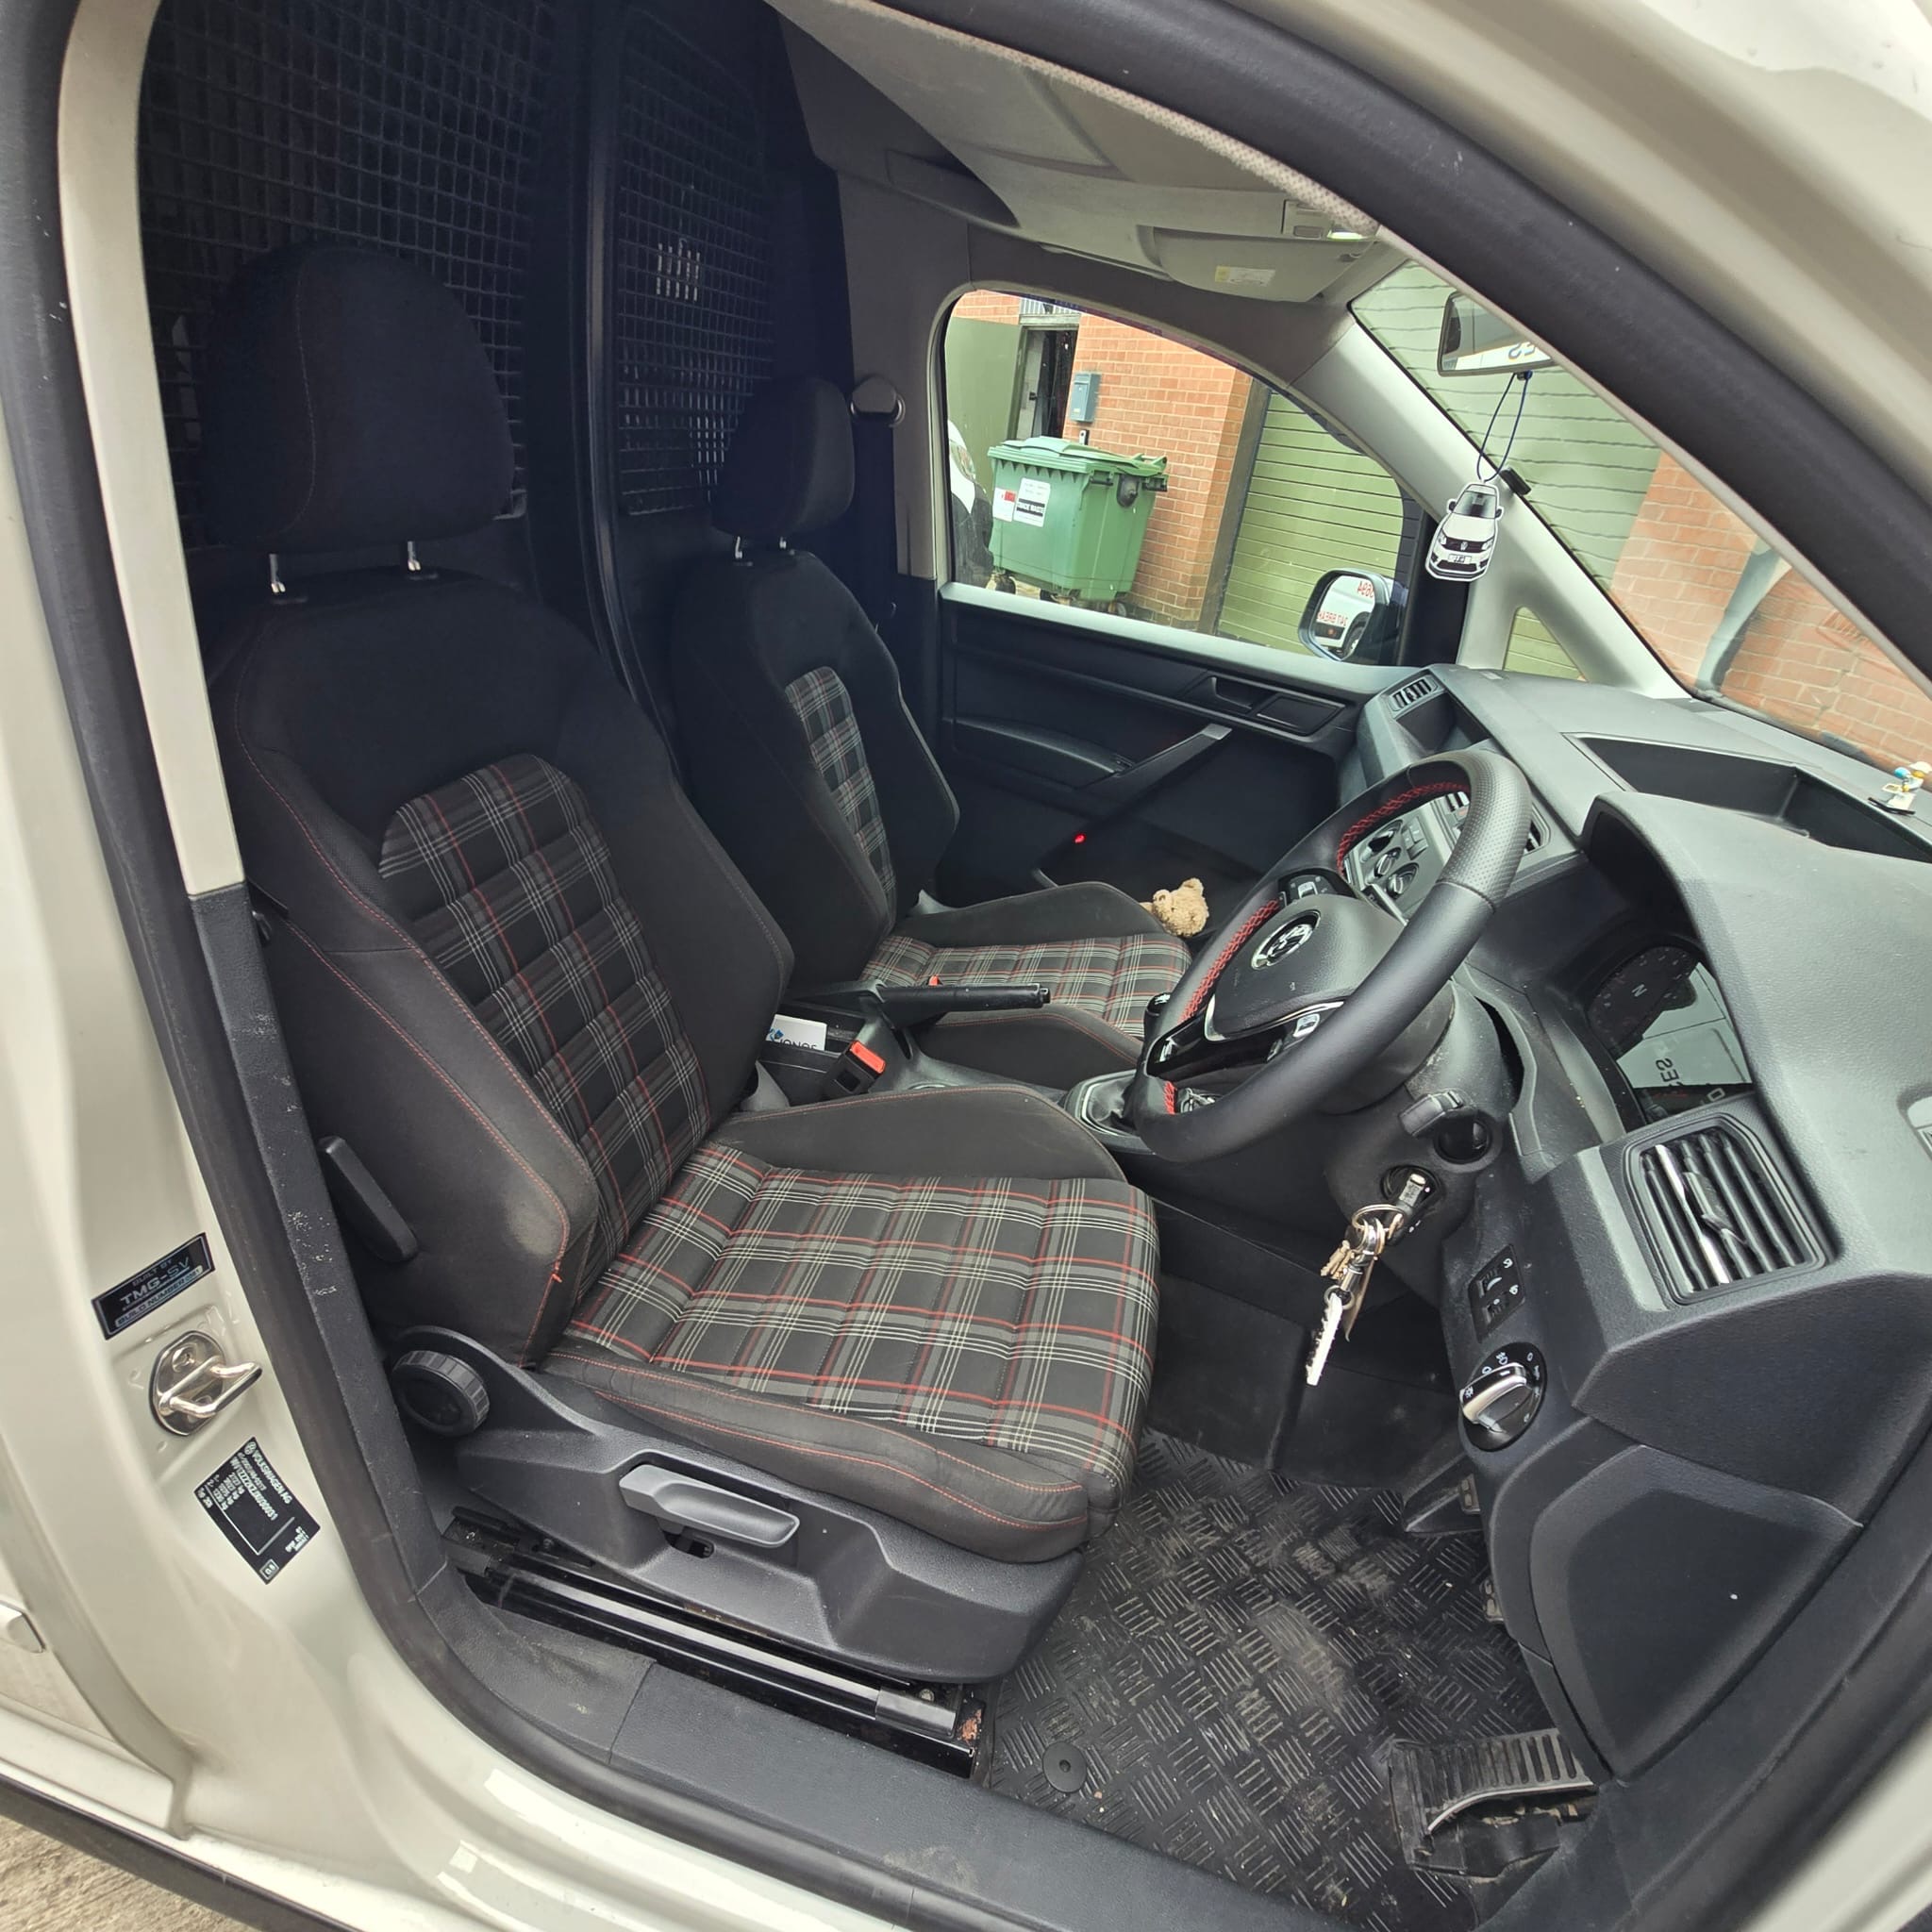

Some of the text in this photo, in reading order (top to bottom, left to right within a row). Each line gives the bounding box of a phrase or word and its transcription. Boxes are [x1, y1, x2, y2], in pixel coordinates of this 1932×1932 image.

[121, 1257, 190, 1305] TMG-SV
[252, 1450, 286, 1492] VOLKSWAGEN
[281, 1491, 292, 1504] AG
